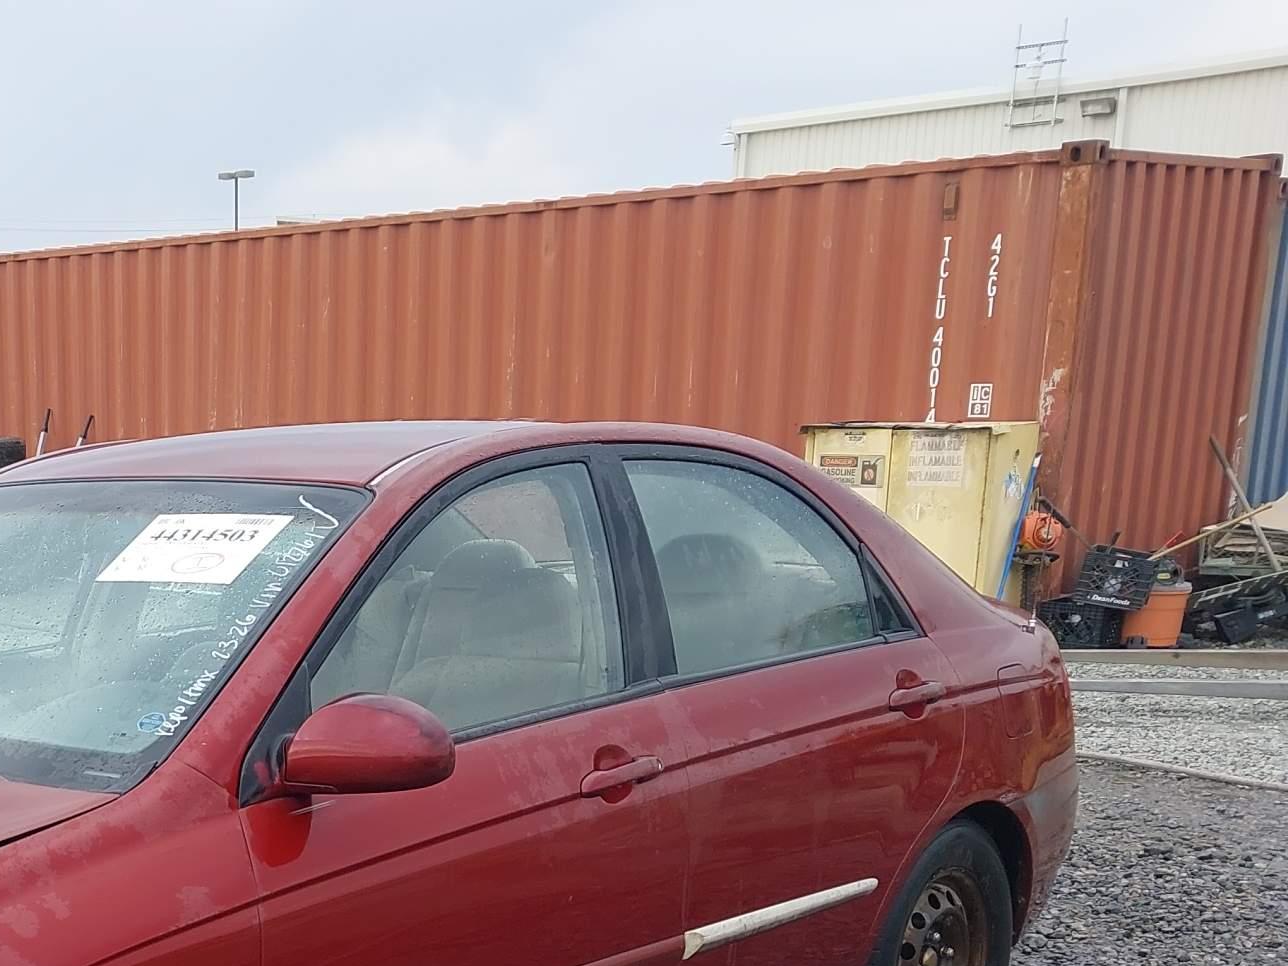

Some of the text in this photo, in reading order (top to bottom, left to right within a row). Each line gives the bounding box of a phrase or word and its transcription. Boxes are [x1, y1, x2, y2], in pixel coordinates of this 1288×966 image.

[935, 236, 953, 320] TCLU
[986, 233, 1002, 318] 42G1
[972, 403, 988, 415] 81
[825, 457, 855, 466] DANGER
[150, 528, 260, 543] 44314503
